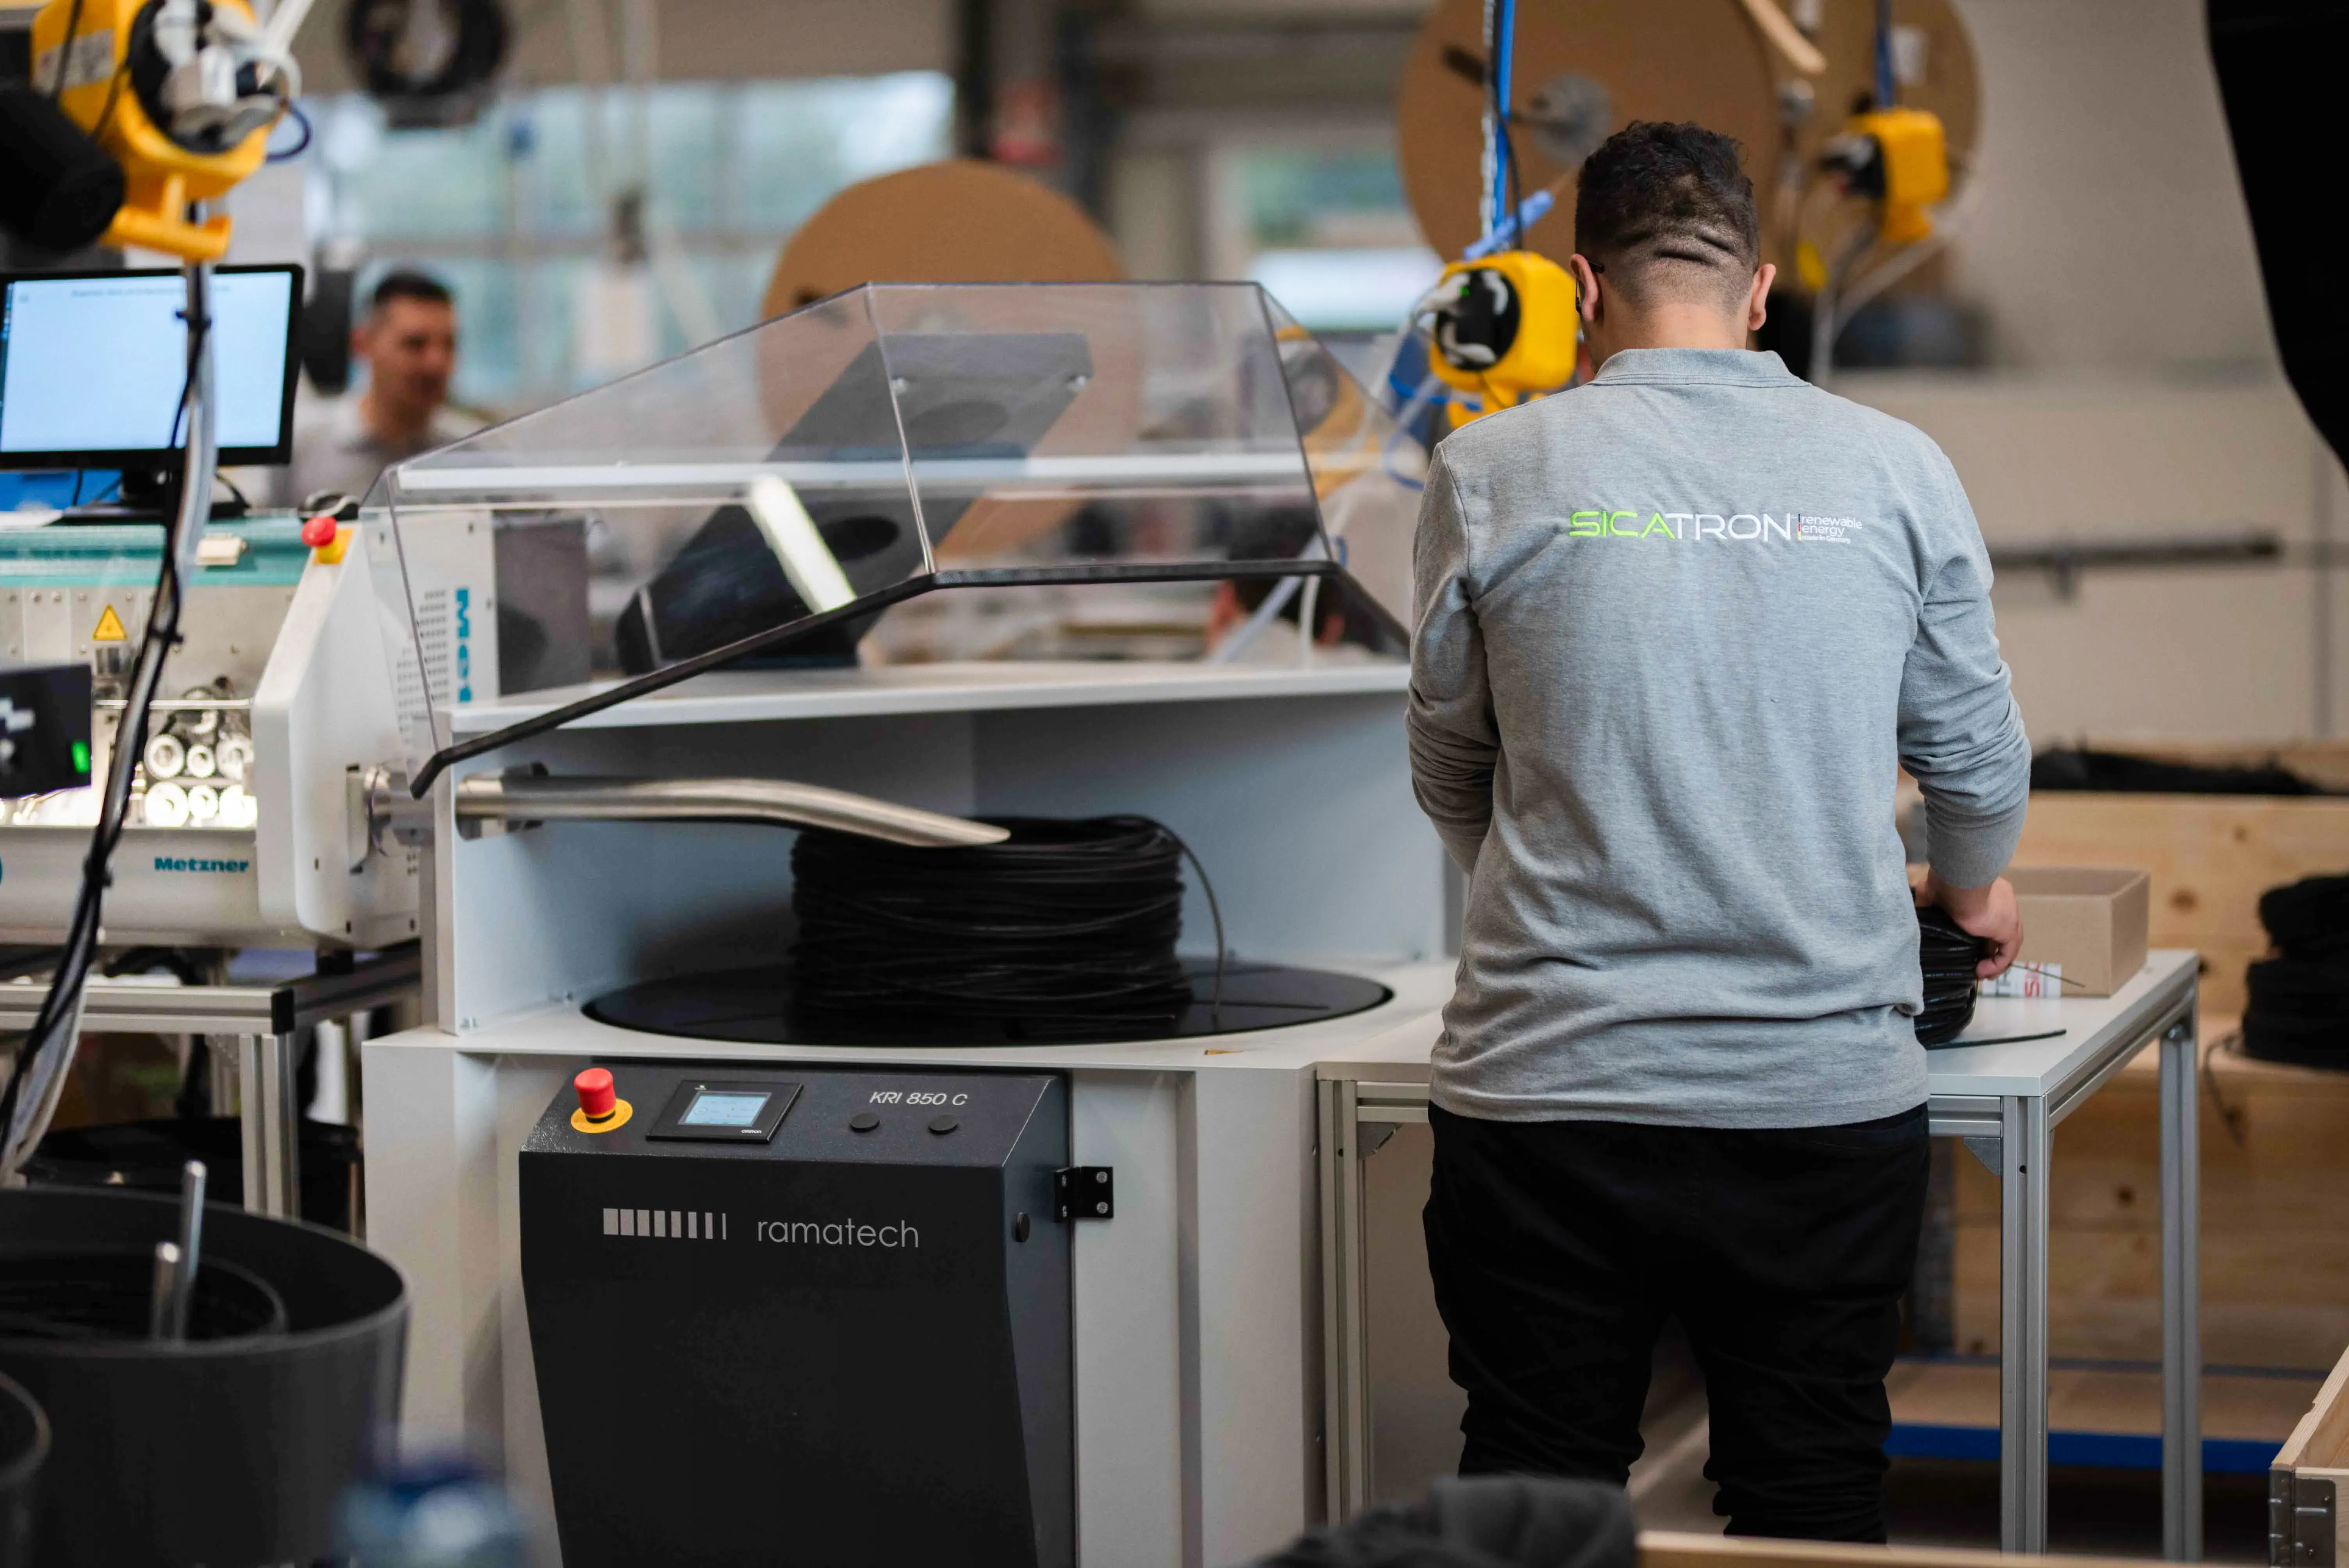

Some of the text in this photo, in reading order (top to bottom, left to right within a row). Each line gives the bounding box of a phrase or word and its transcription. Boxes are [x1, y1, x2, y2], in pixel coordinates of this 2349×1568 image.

[1569, 510, 1791, 542] SICATRON
[1802, 516, 1863, 529] renewable
[1802, 525, 1845, 537] energy
[1826, 536, 1851, 544] Germany
[155, 857, 249, 872] Metzner
[869, 1092, 968, 1106] KRI 850 C
[757, 1218, 919, 1248] ramatech
